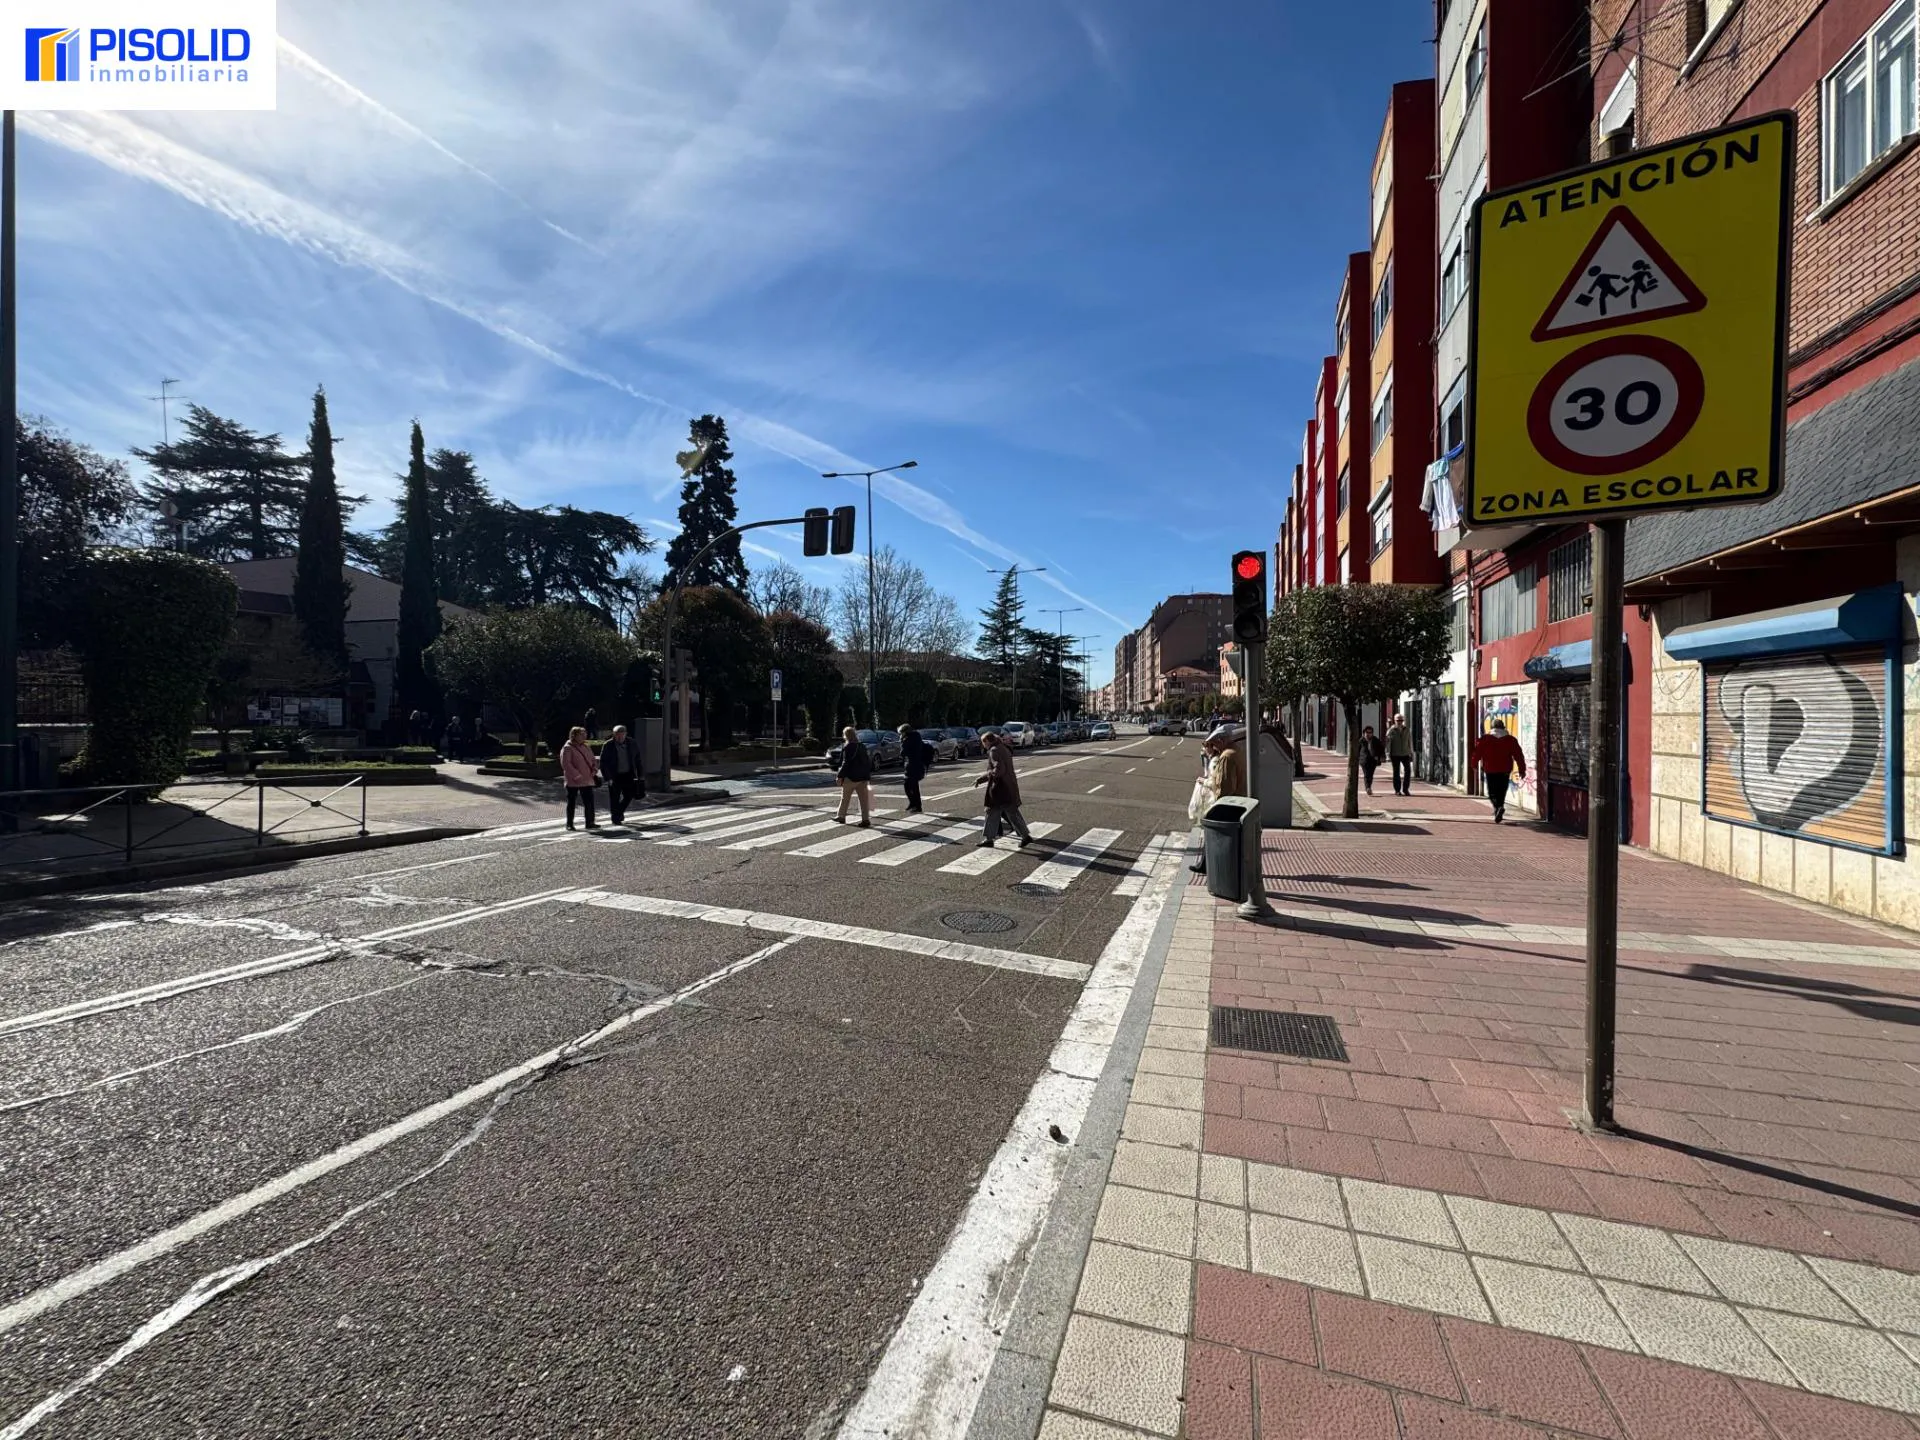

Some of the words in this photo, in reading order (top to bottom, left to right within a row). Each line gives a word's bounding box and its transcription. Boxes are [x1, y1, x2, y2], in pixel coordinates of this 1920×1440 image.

[1499, 133, 1760, 228] ATENCIÓN
[1563, 380, 1662, 431] 30
[1479, 488, 1571, 514] ZONA
[1584, 467, 1759, 504] ESCOLAR
[773, 672, 780, 687] P
